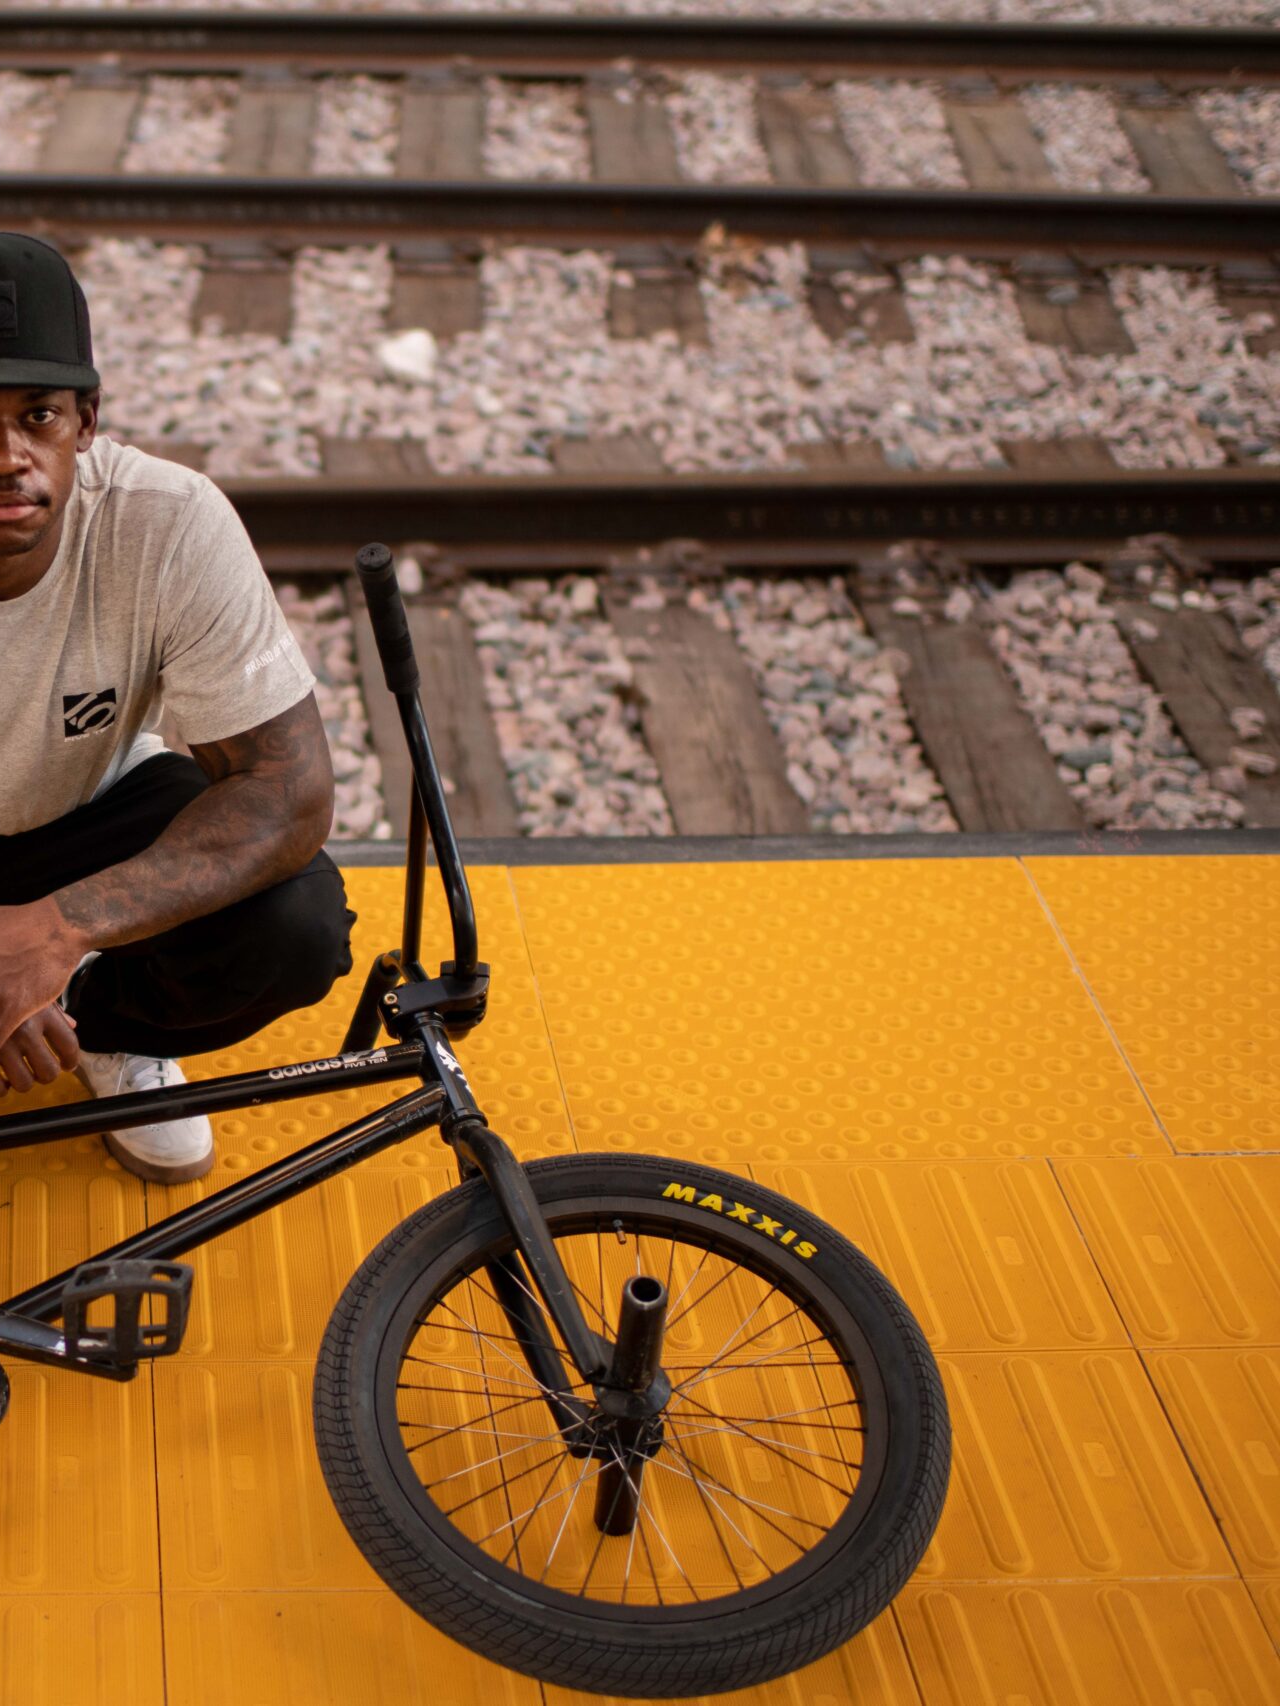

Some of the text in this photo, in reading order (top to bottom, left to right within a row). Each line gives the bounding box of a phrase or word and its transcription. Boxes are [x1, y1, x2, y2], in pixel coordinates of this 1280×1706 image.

[269, 1057, 343, 1080] adidas
[343, 1055, 389, 1070] FIVE TEN
[662, 1182, 819, 1259] MAXXIS
